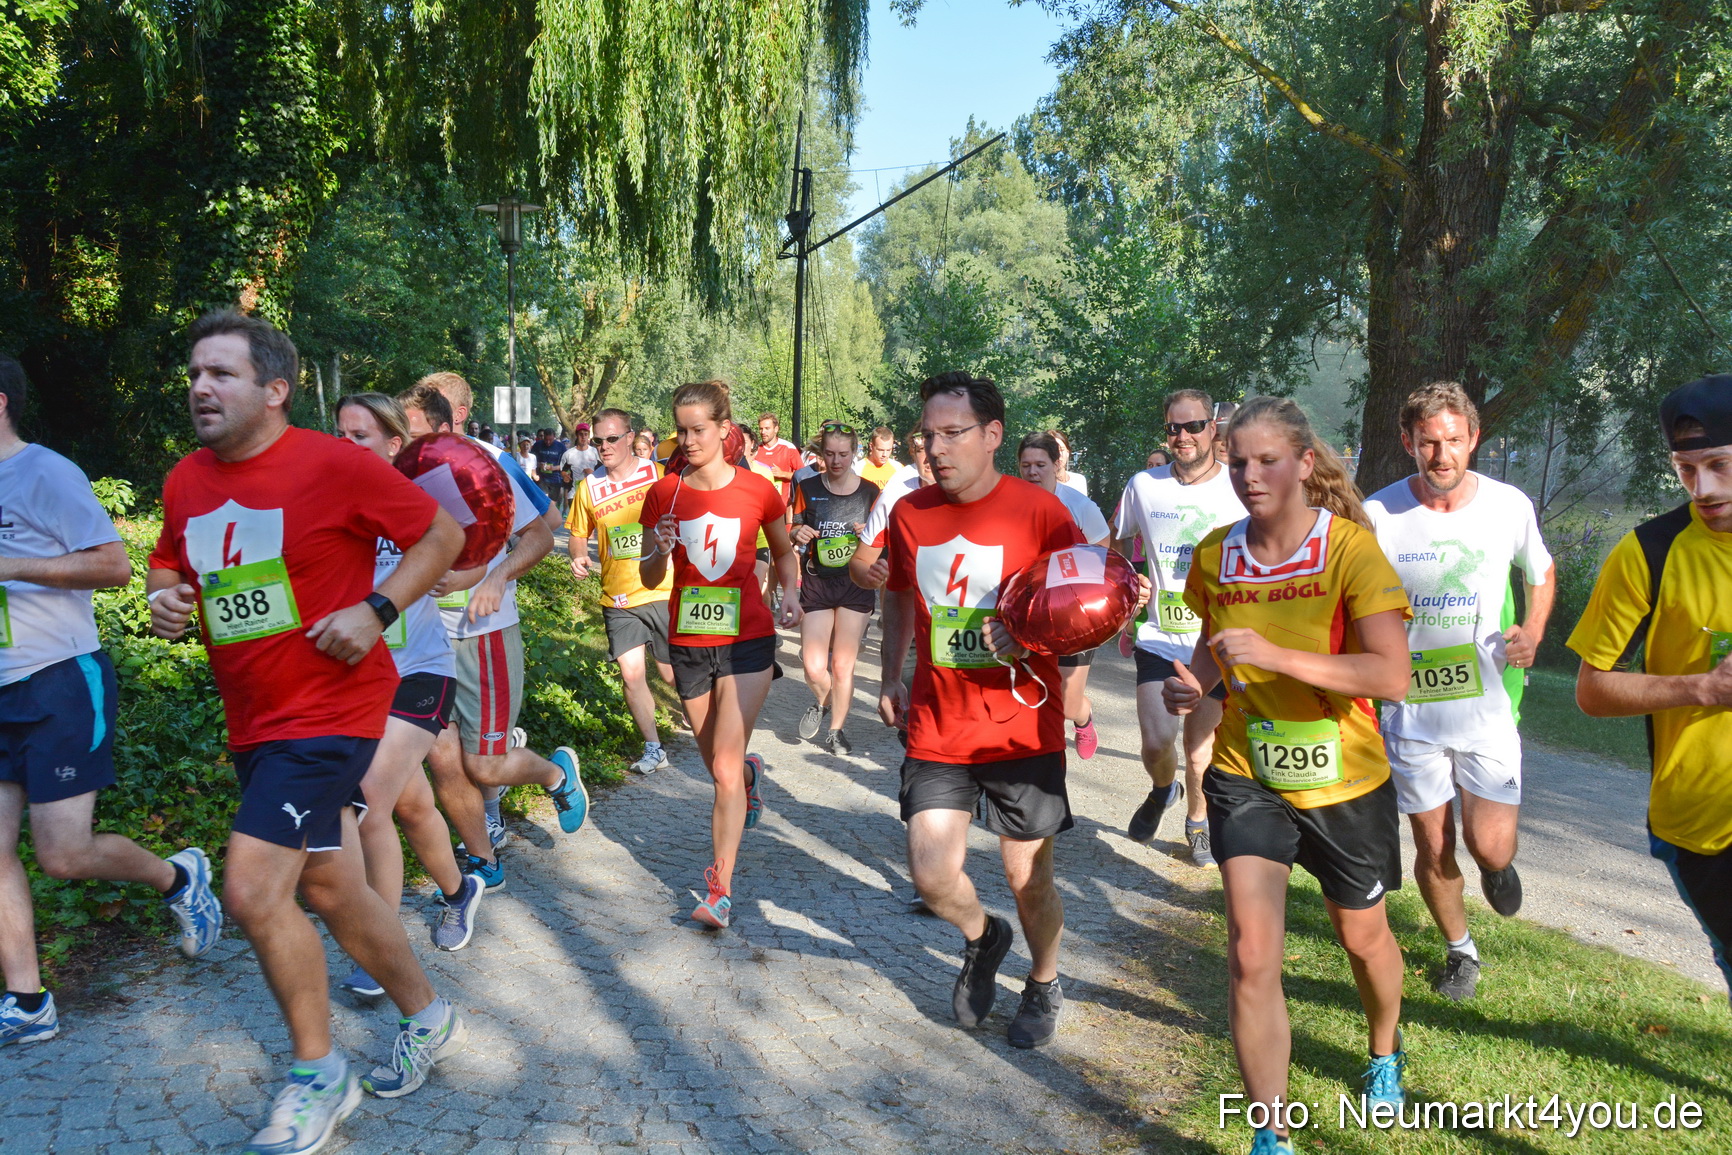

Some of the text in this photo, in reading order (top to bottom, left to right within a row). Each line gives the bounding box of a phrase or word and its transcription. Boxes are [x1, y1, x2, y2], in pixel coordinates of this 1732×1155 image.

[594, 489, 649, 520] MAX BÖ
[1150, 511, 1179, 520] BERATA
[818, 521, 847, 530] HECK
[821, 530, 856, 538] DESI
[827, 545, 852, 560] 802
[1398, 552, 1438, 563] BERATA
[1216, 590, 1261, 607] MAX
[1267, 582, 1327, 602] BÖGL
[1413, 592, 1478, 610] Laufend
[216, 589, 270, 623] 388
[690, 603, 724, 621] 409
[1164, 604, 1195, 621] 103
[1405, 611, 1484, 630] erfolgreich
[1411, 664, 1470, 689] 1035
[1258, 743, 1329, 771] 1296
